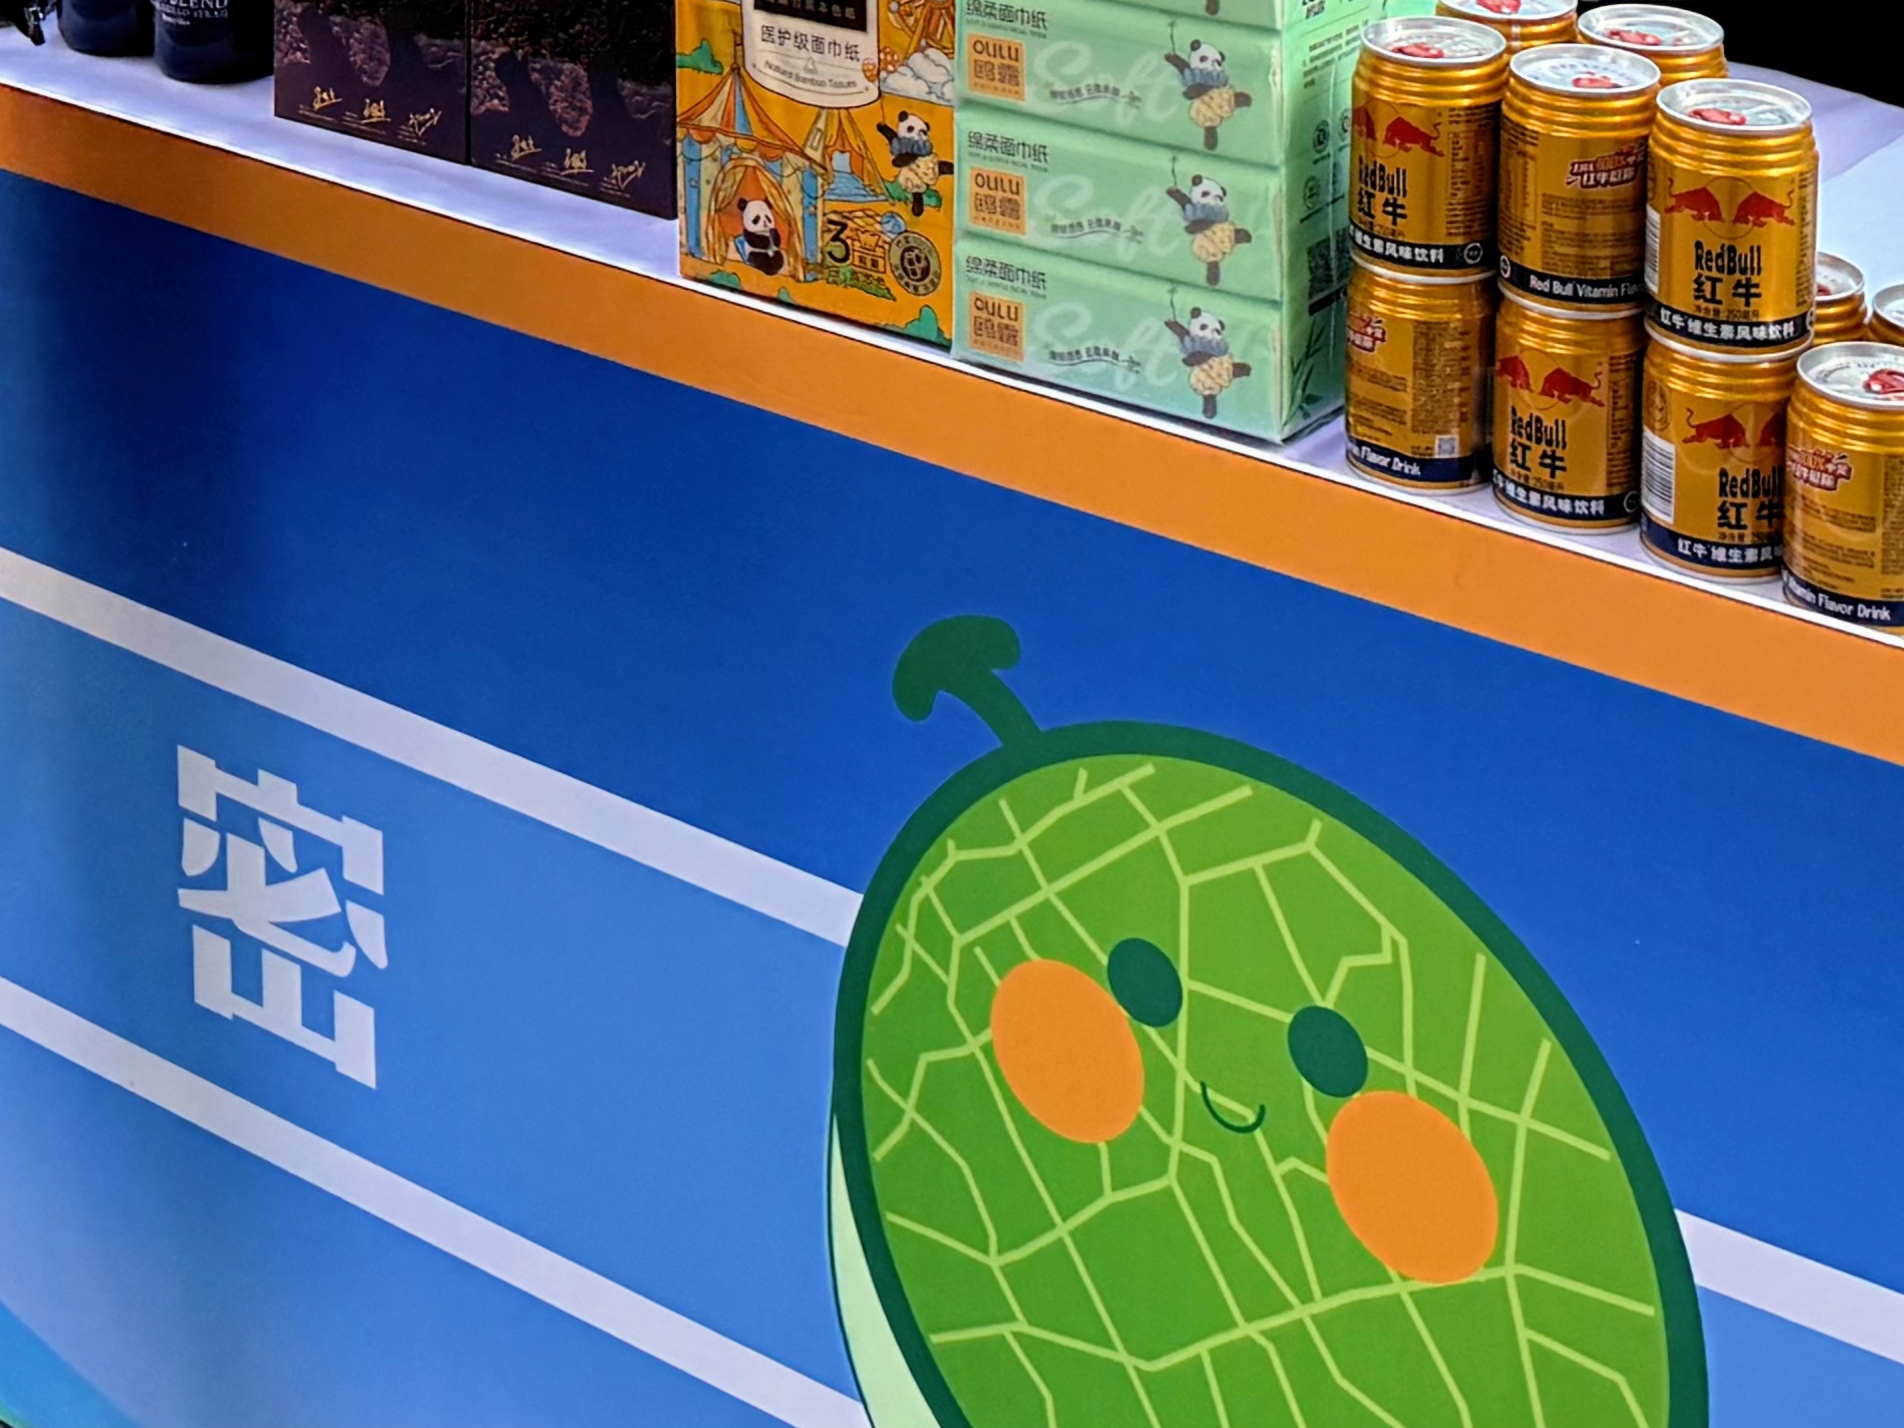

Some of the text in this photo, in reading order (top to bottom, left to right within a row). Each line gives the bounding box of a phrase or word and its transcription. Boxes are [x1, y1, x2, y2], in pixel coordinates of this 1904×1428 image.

[761, 24, 861, 63] 医护级面巾纸
[973, 39, 1020, 62] OULU
[975, 173, 1021, 196] OULU
[1358, 154, 1408, 199] RedBull
[1357, 191, 1408, 226] 红牛
[1694, 239, 1763, 276] RedBull
[1693, 272, 1763, 308] 红牛
[974, 296, 1019, 322] OULU
[1511, 405, 1567, 450] RedBull
[1361, 447, 1422, 477] Flavor Drink
[1509, 438, 1567, 479] 红牛
[1717, 500, 1783, 530] 红牛
[1818, 593, 1891, 622] Flavor Drink
